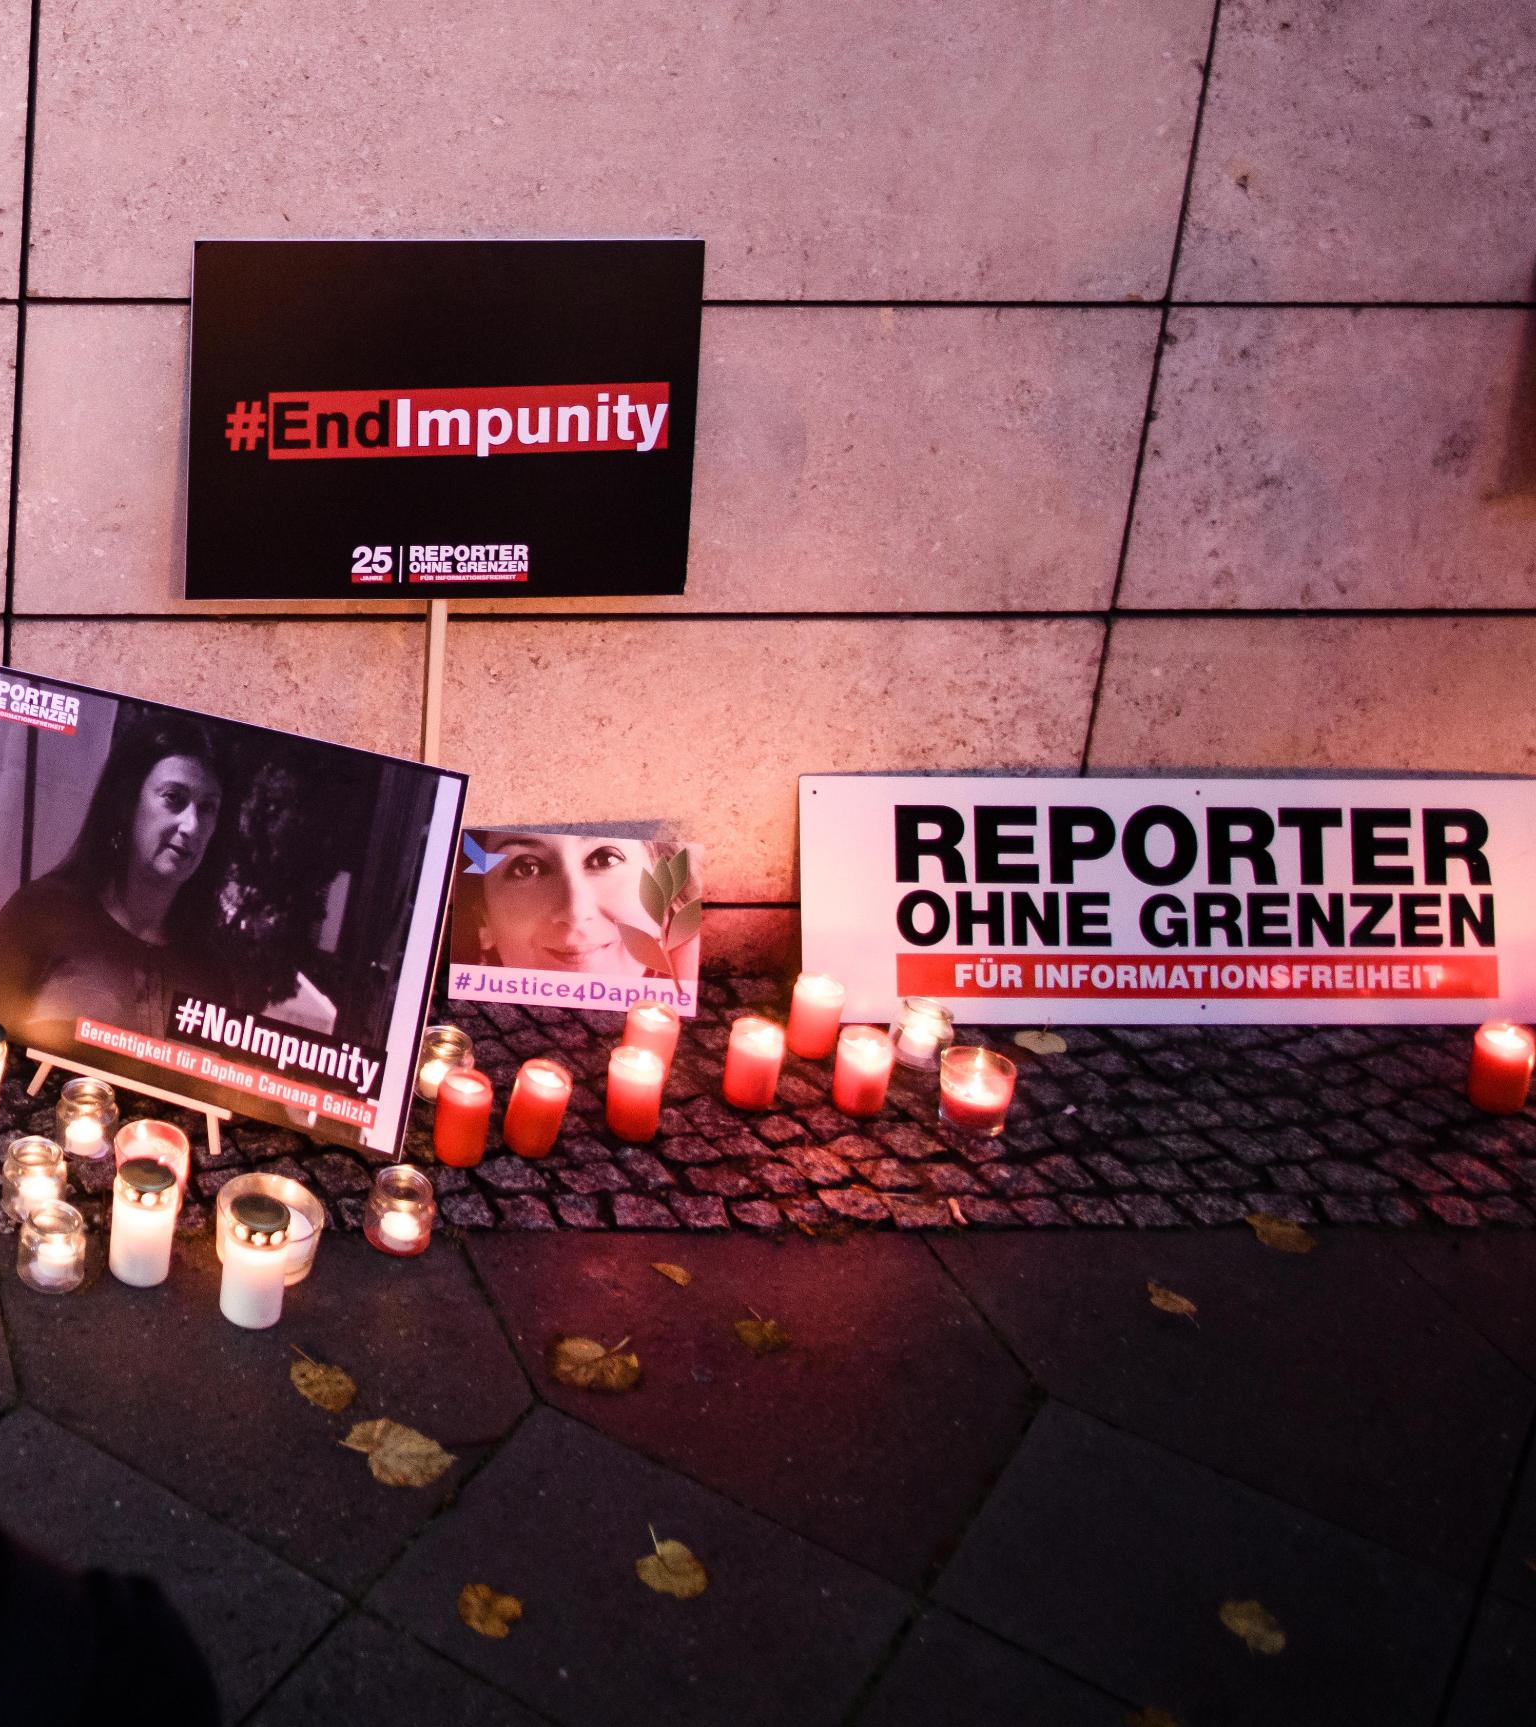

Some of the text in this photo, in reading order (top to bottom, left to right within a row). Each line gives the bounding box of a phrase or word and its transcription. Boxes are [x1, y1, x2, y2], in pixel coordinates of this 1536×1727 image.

[225, 393, 669, 457] #EndImpunity
[351, 545, 393, 574] 25
[409, 544, 529, 562] REPORTER
[409, 560, 529, 574] OHNE GRENZEN
[10, 701, 79, 727] GRENZEN
[893, 803, 1493, 887] REPORTER
[895, 889, 1496, 948] OHNE GRENZEN
[454, 972, 692, 1008] #Justice4Daphne
[954, 956, 1443, 990] FÜR INFORMATIONSFREIHEIT
[175, 997, 380, 1095] #NoImpunity
[80, 1021, 372, 1125] Gerechtigkeit für Daphne Caruana Galizia
